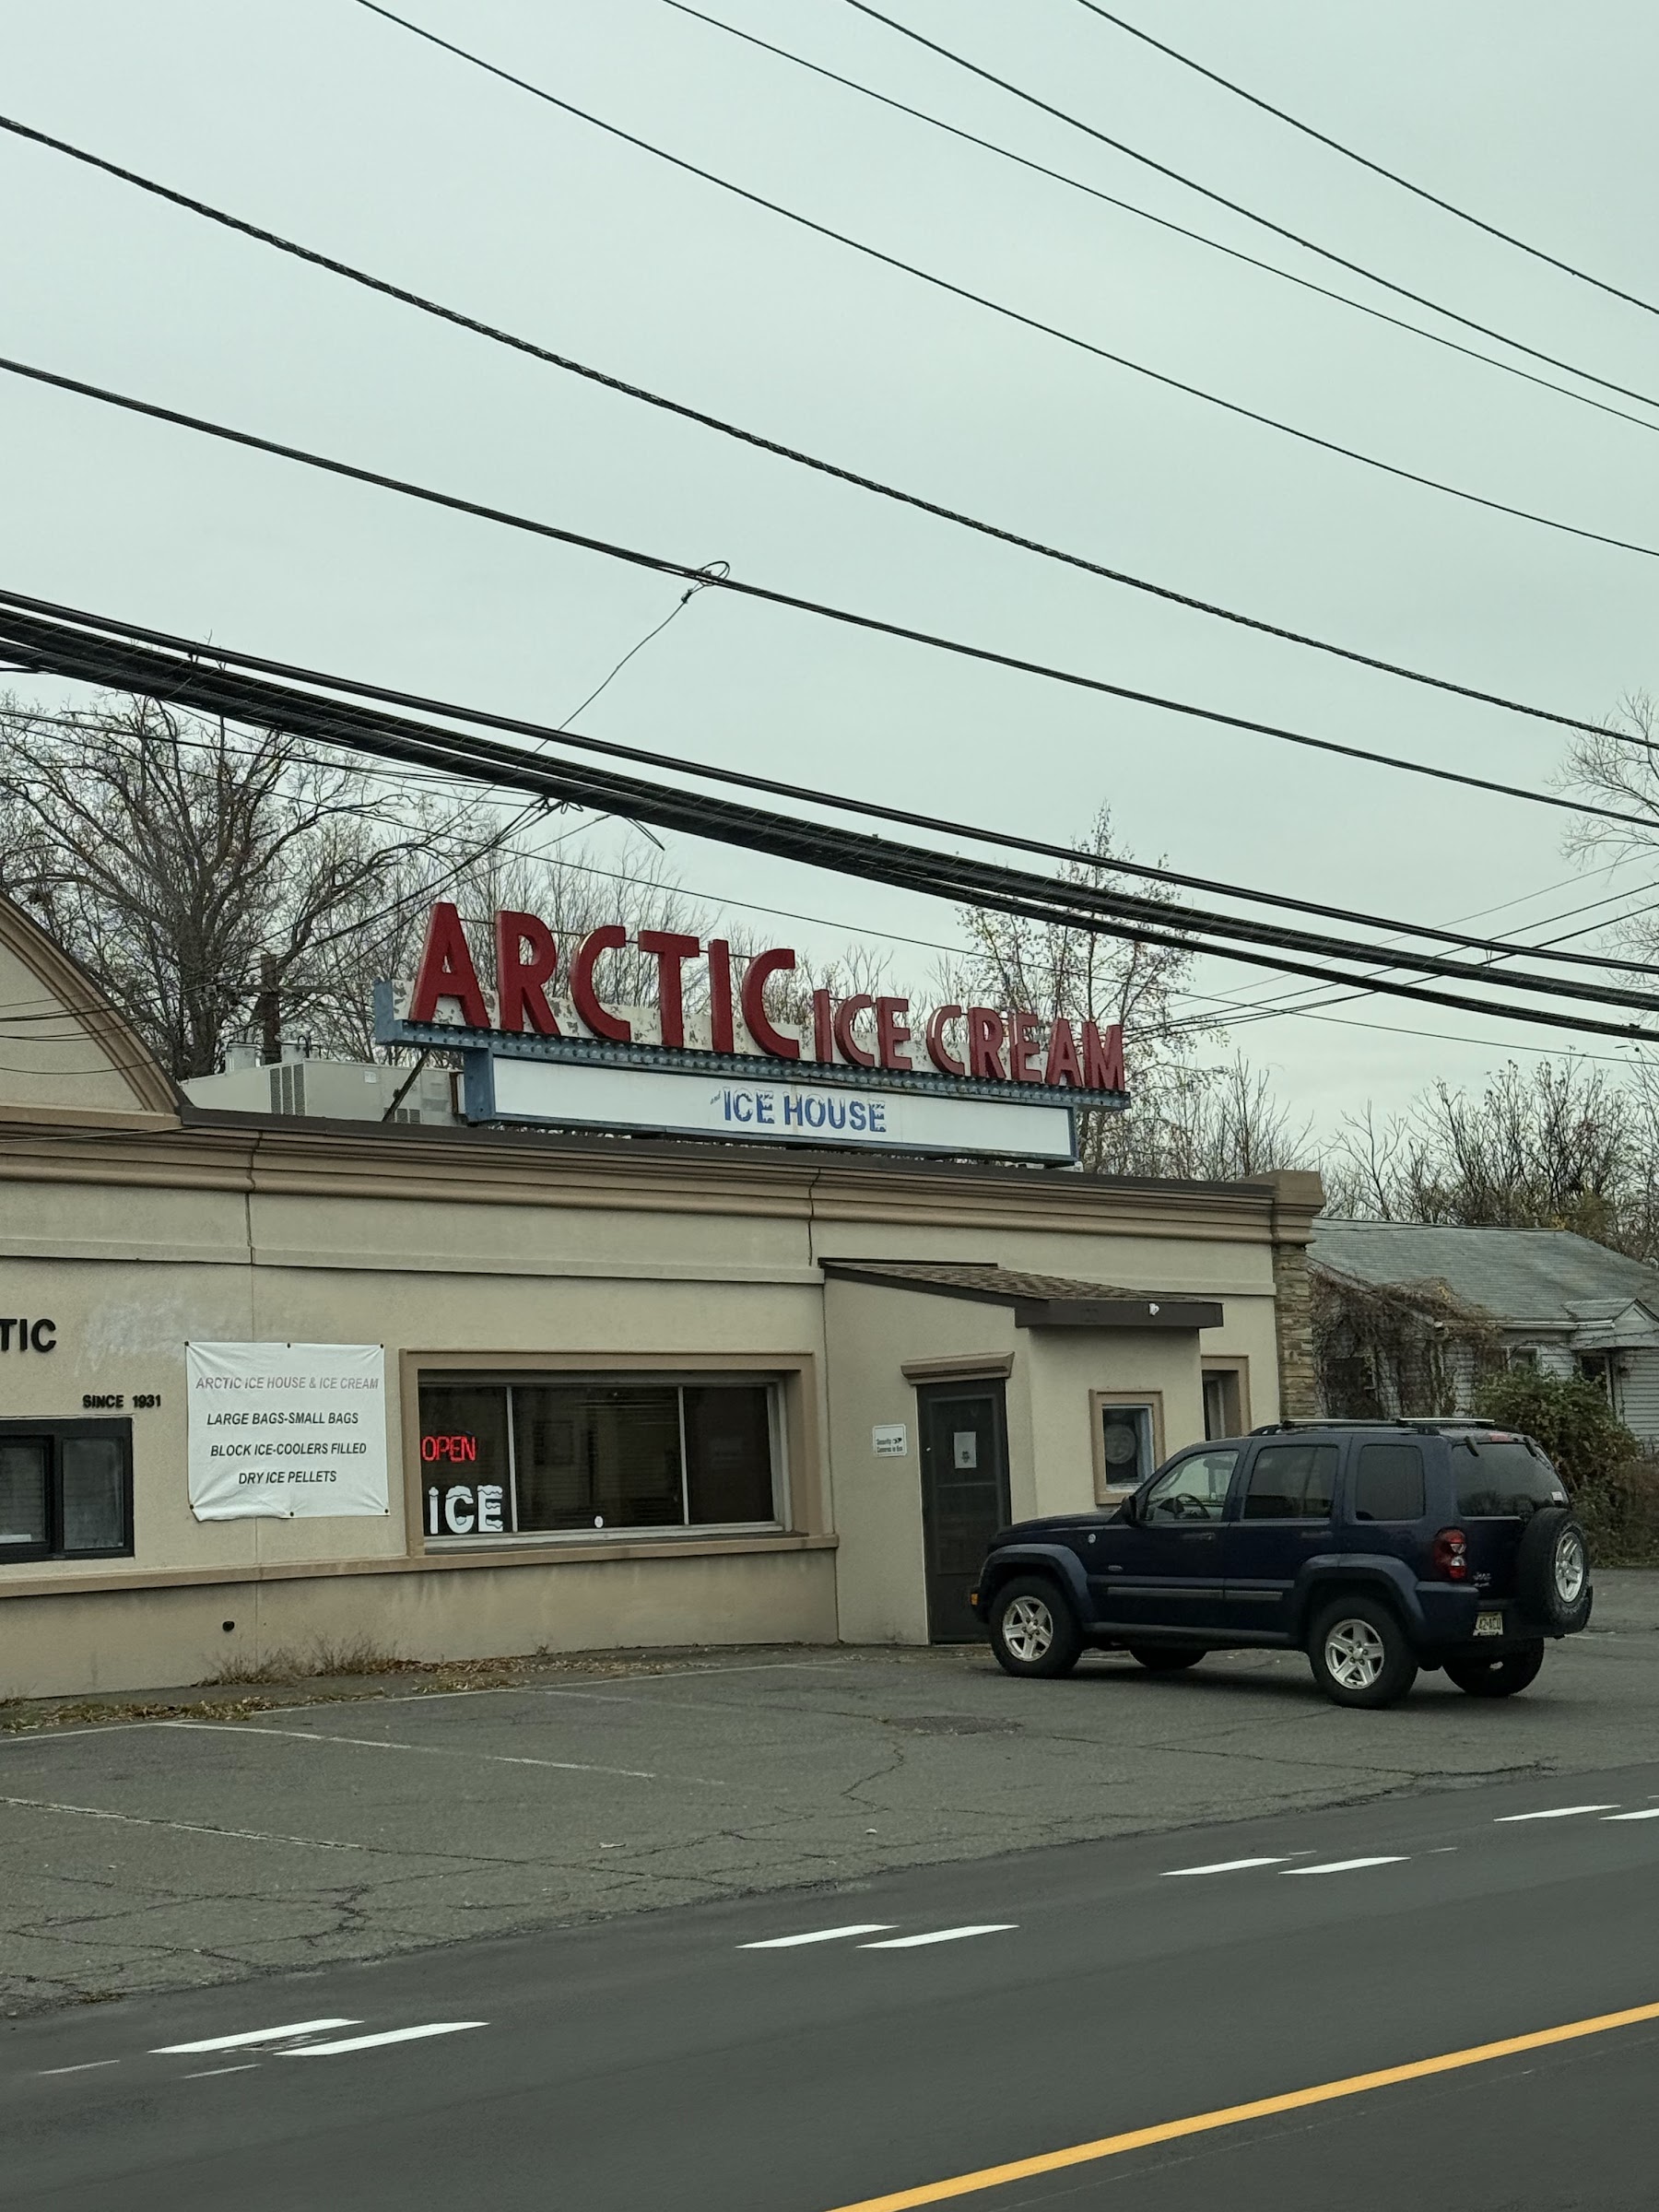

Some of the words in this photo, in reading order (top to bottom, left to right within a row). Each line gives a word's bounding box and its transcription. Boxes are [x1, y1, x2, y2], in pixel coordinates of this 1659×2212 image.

[408, 901, 800, 1059] ARCTIC
[813, 989, 912, 1071] ICE
[926, 1005, 1125, 1091] CREAM
[723, 1086, 775, 1124] ICE
[783, 1091, 886, 1132] HOUSE
[195, 1377, 242, 1389] ARCTIC
[244, 1377, 265, 1389] ICE
[267, 1376, 306, 1389] HOUSE
[309, 1377, 316, 1389] &
[319, 1378, 337, 1389] ICE
[340, 1378, 379, 1389] CREAM
[82, 1394, 124, 1408] SINCE
[132, 1394, 161, 1408] 1931
[206, 1413, 250, 1425] LARGE
[252, 1412, 325, 1425] BAGS-SMALL
[328, 1412, 359, 1424] BAGS
[210, 1444, 252, 1456] BLOCK
[254, 1442, 328, 1455] ICE-COOLERS
[331, 1442, 367, 1454] FILLED
[422, 1436, 476, 1463] OPEN
[239, 1472, 264, 1484] DRY
[265, 1472, 285, 1483] ICE
[288, 1470, 337, 1483] PELLETS
[429, 1485, 503, 1535] ICE
